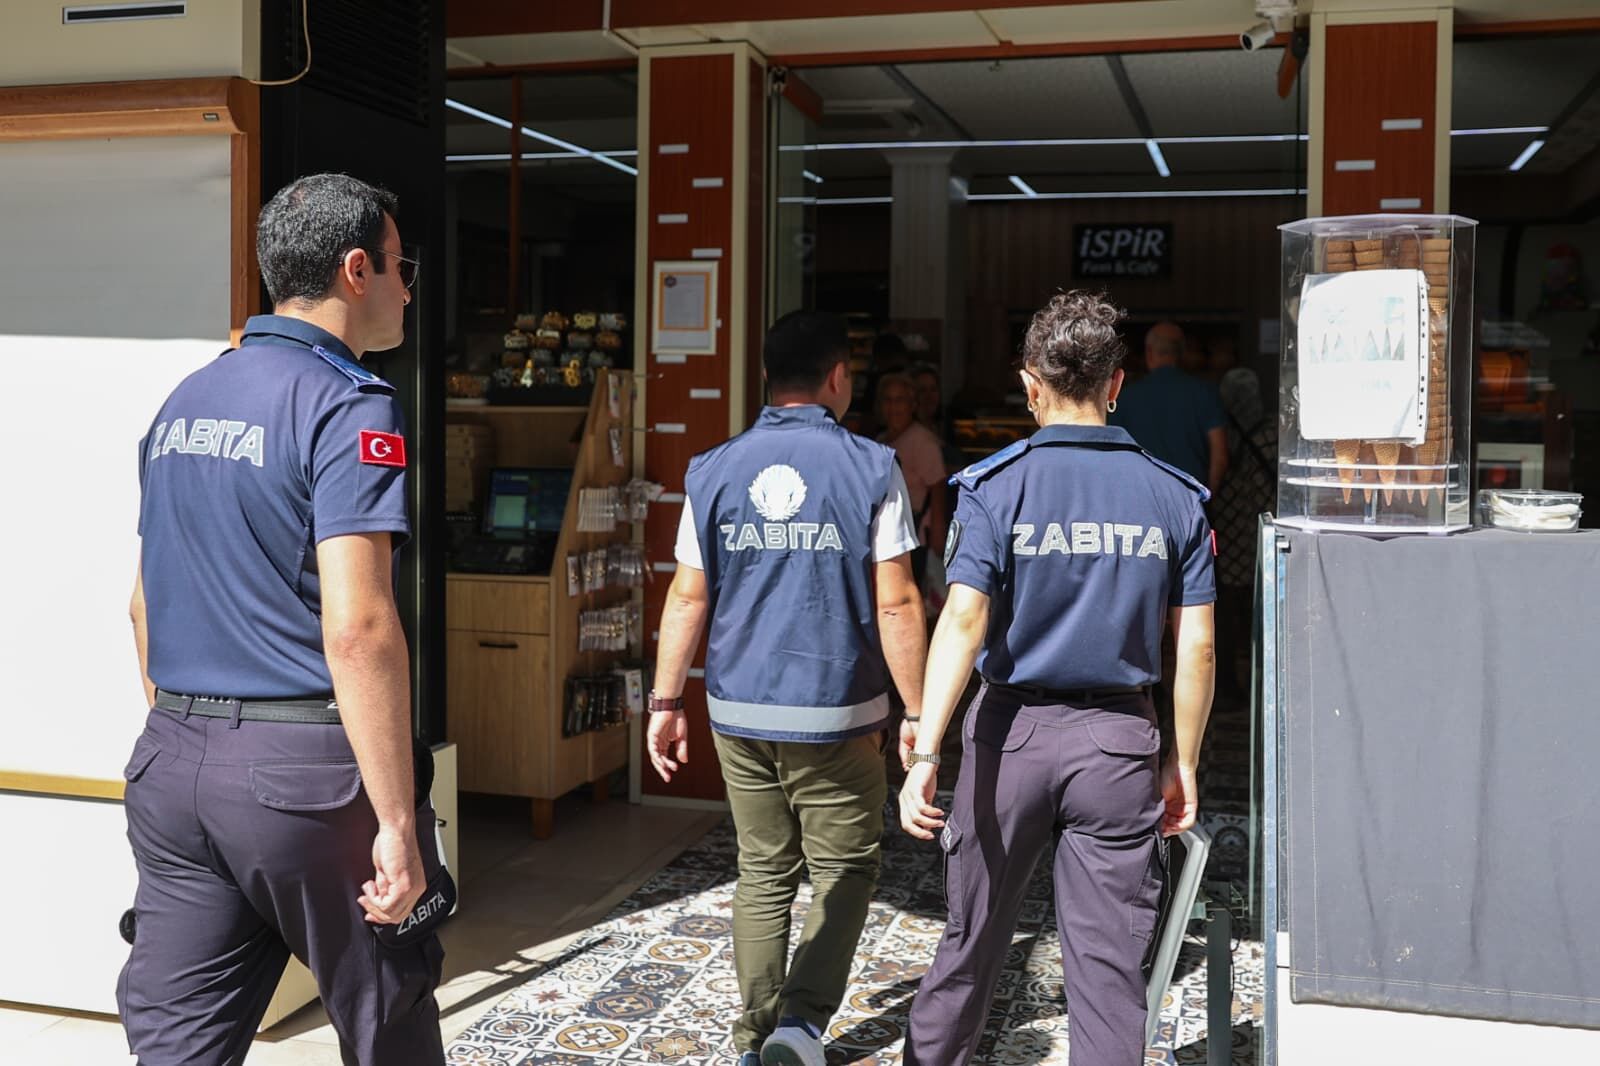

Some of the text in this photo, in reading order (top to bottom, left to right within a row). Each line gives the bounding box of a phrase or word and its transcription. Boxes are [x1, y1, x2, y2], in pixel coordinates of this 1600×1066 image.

[151, 418, 264, 467] ZABITA
[720, 523, 843, 551] ZABITA
[1012, 522, 1168, 559] ZABITA
[397, 891, 446, 935] ZABITA
